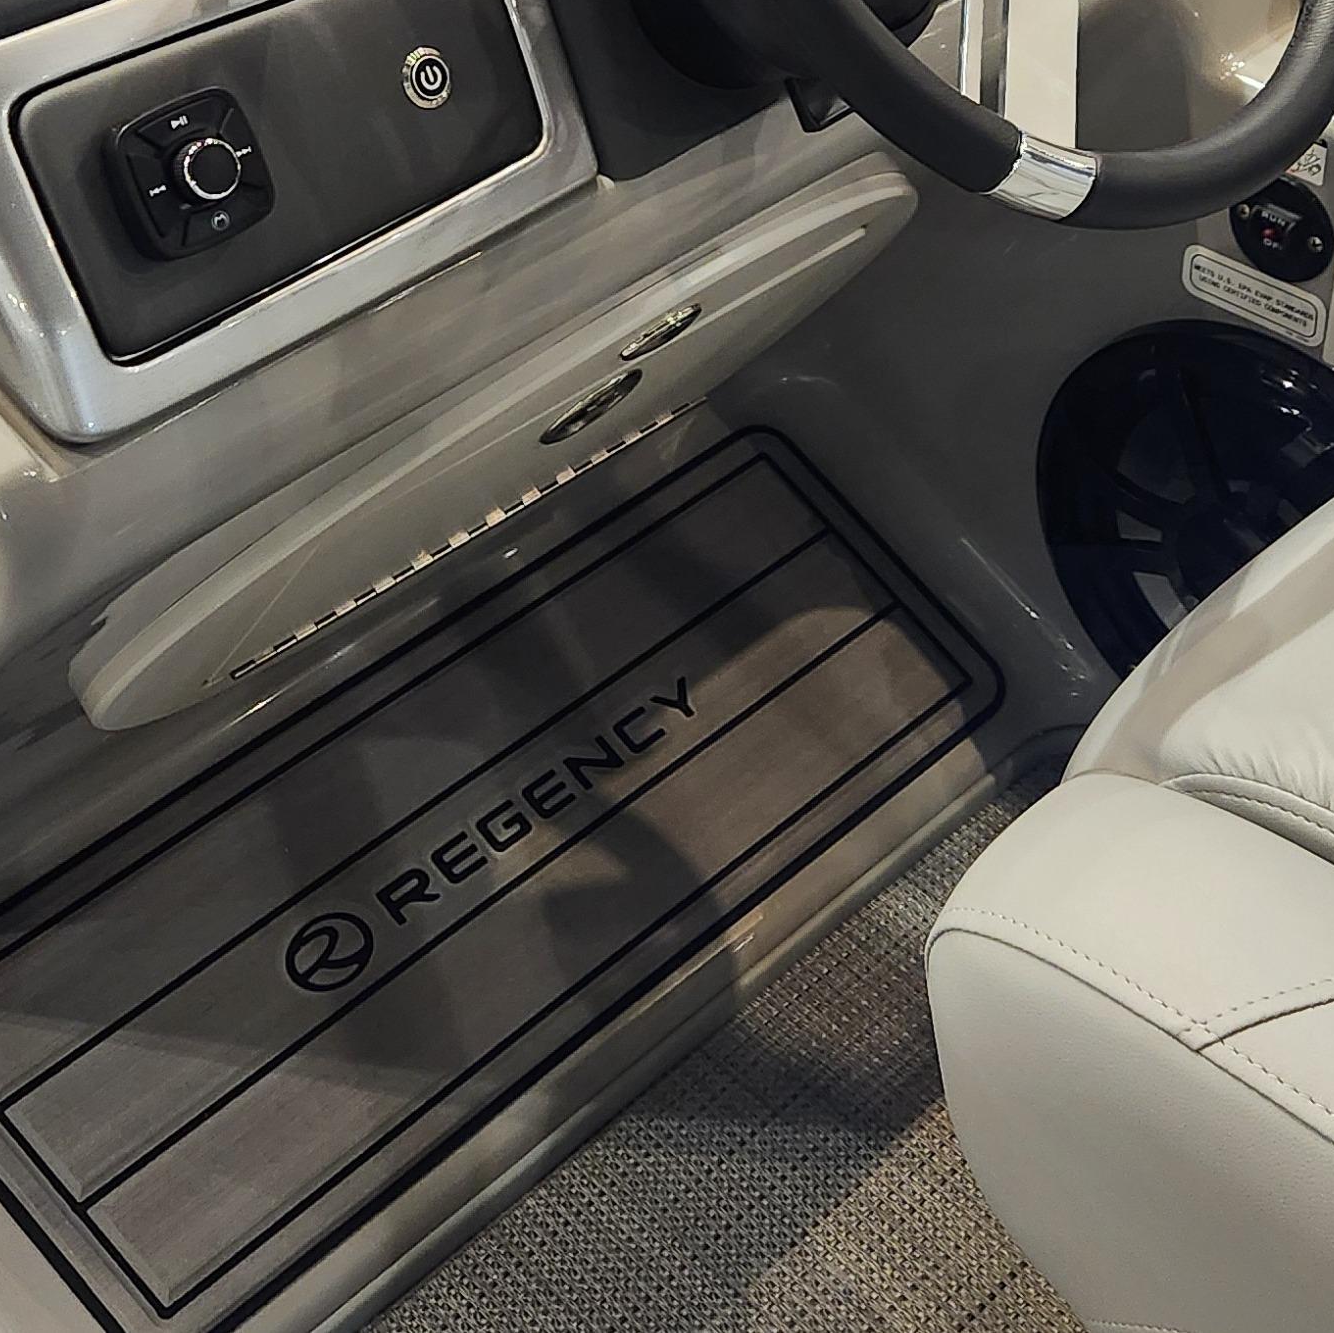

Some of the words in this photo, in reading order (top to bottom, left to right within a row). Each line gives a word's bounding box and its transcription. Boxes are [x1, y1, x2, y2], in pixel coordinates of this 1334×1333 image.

[1261, 210, 1286, 226] RUN
[1194, 262, 1214, 277] MEETS
[1238, 282, 1251, 293] EPA
[1199, 274, 1219, 288] USING
[1223, 284, 1261, 306] CERTIFIED
[1264, 302, 1306, 327] COMPONENTS
[375, 676, 696, 926] REGENCY
